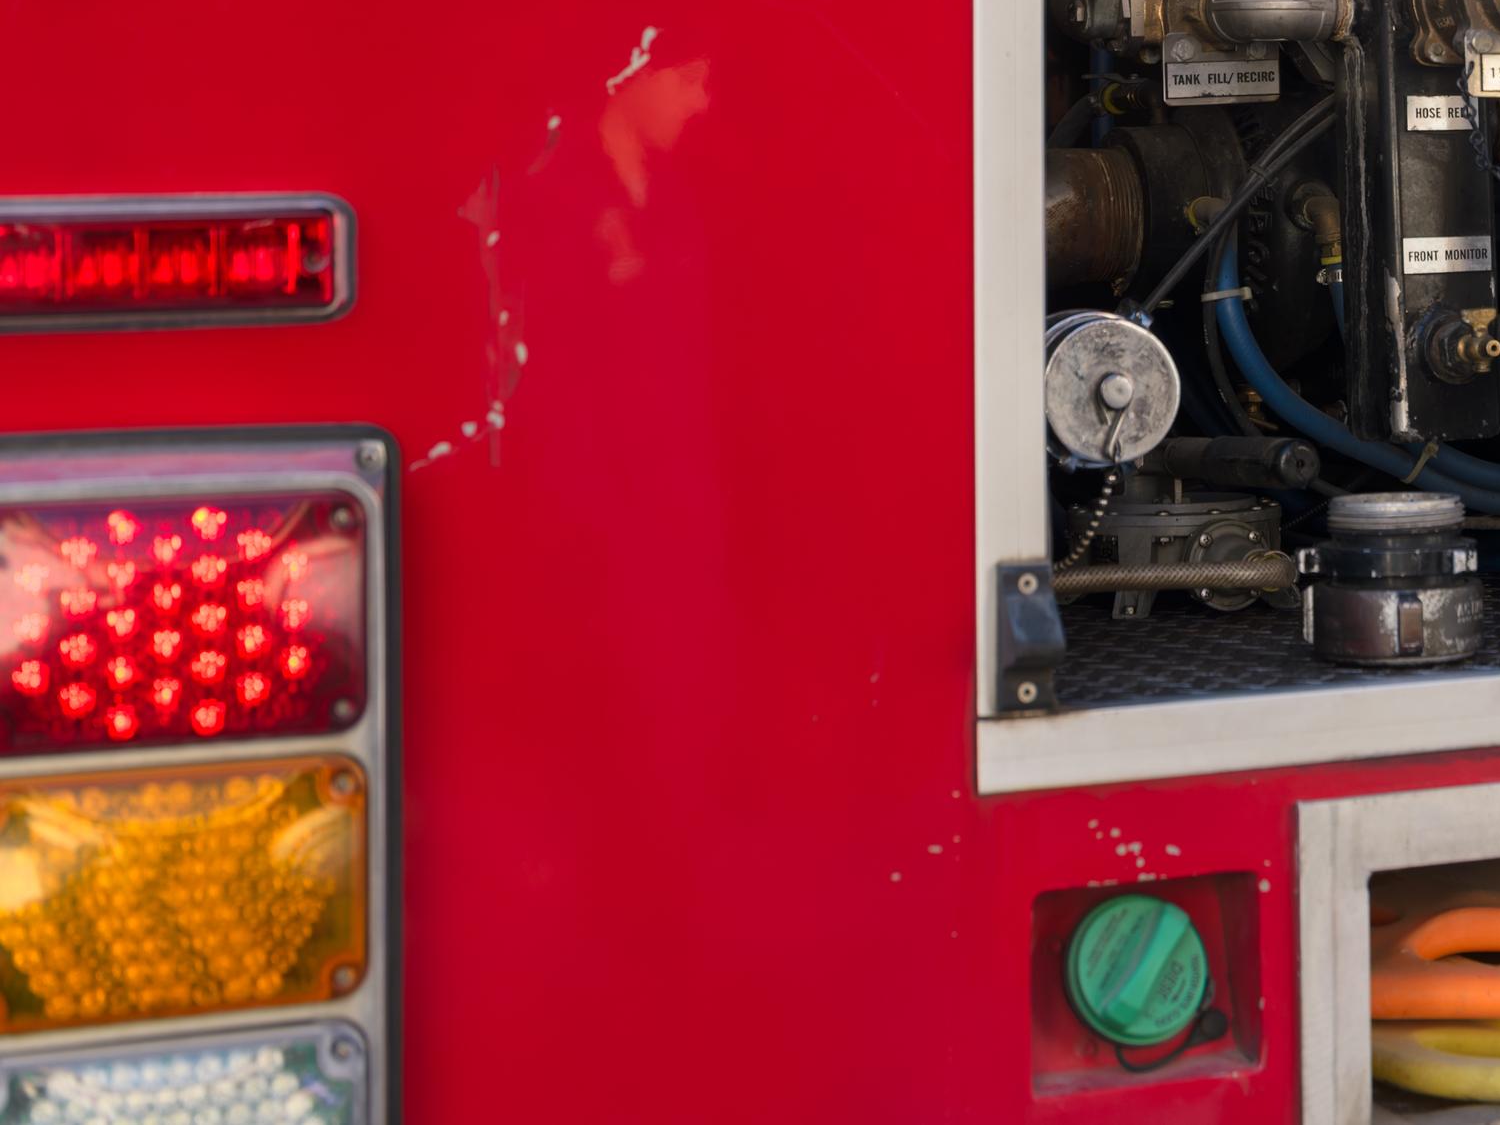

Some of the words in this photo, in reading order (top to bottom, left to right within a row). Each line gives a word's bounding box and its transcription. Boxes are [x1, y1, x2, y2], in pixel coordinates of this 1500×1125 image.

[1172, 74, 1201, 85] TANK
[1237, 71, 1275, 83] RECIRC
[1415, 107, 1441, 119] HOSE
[1448, 107, 1470, 119] RE
[1408, 250, 1439, 262] FRONT
[1444, 248, 1488, 261] MONITOR
